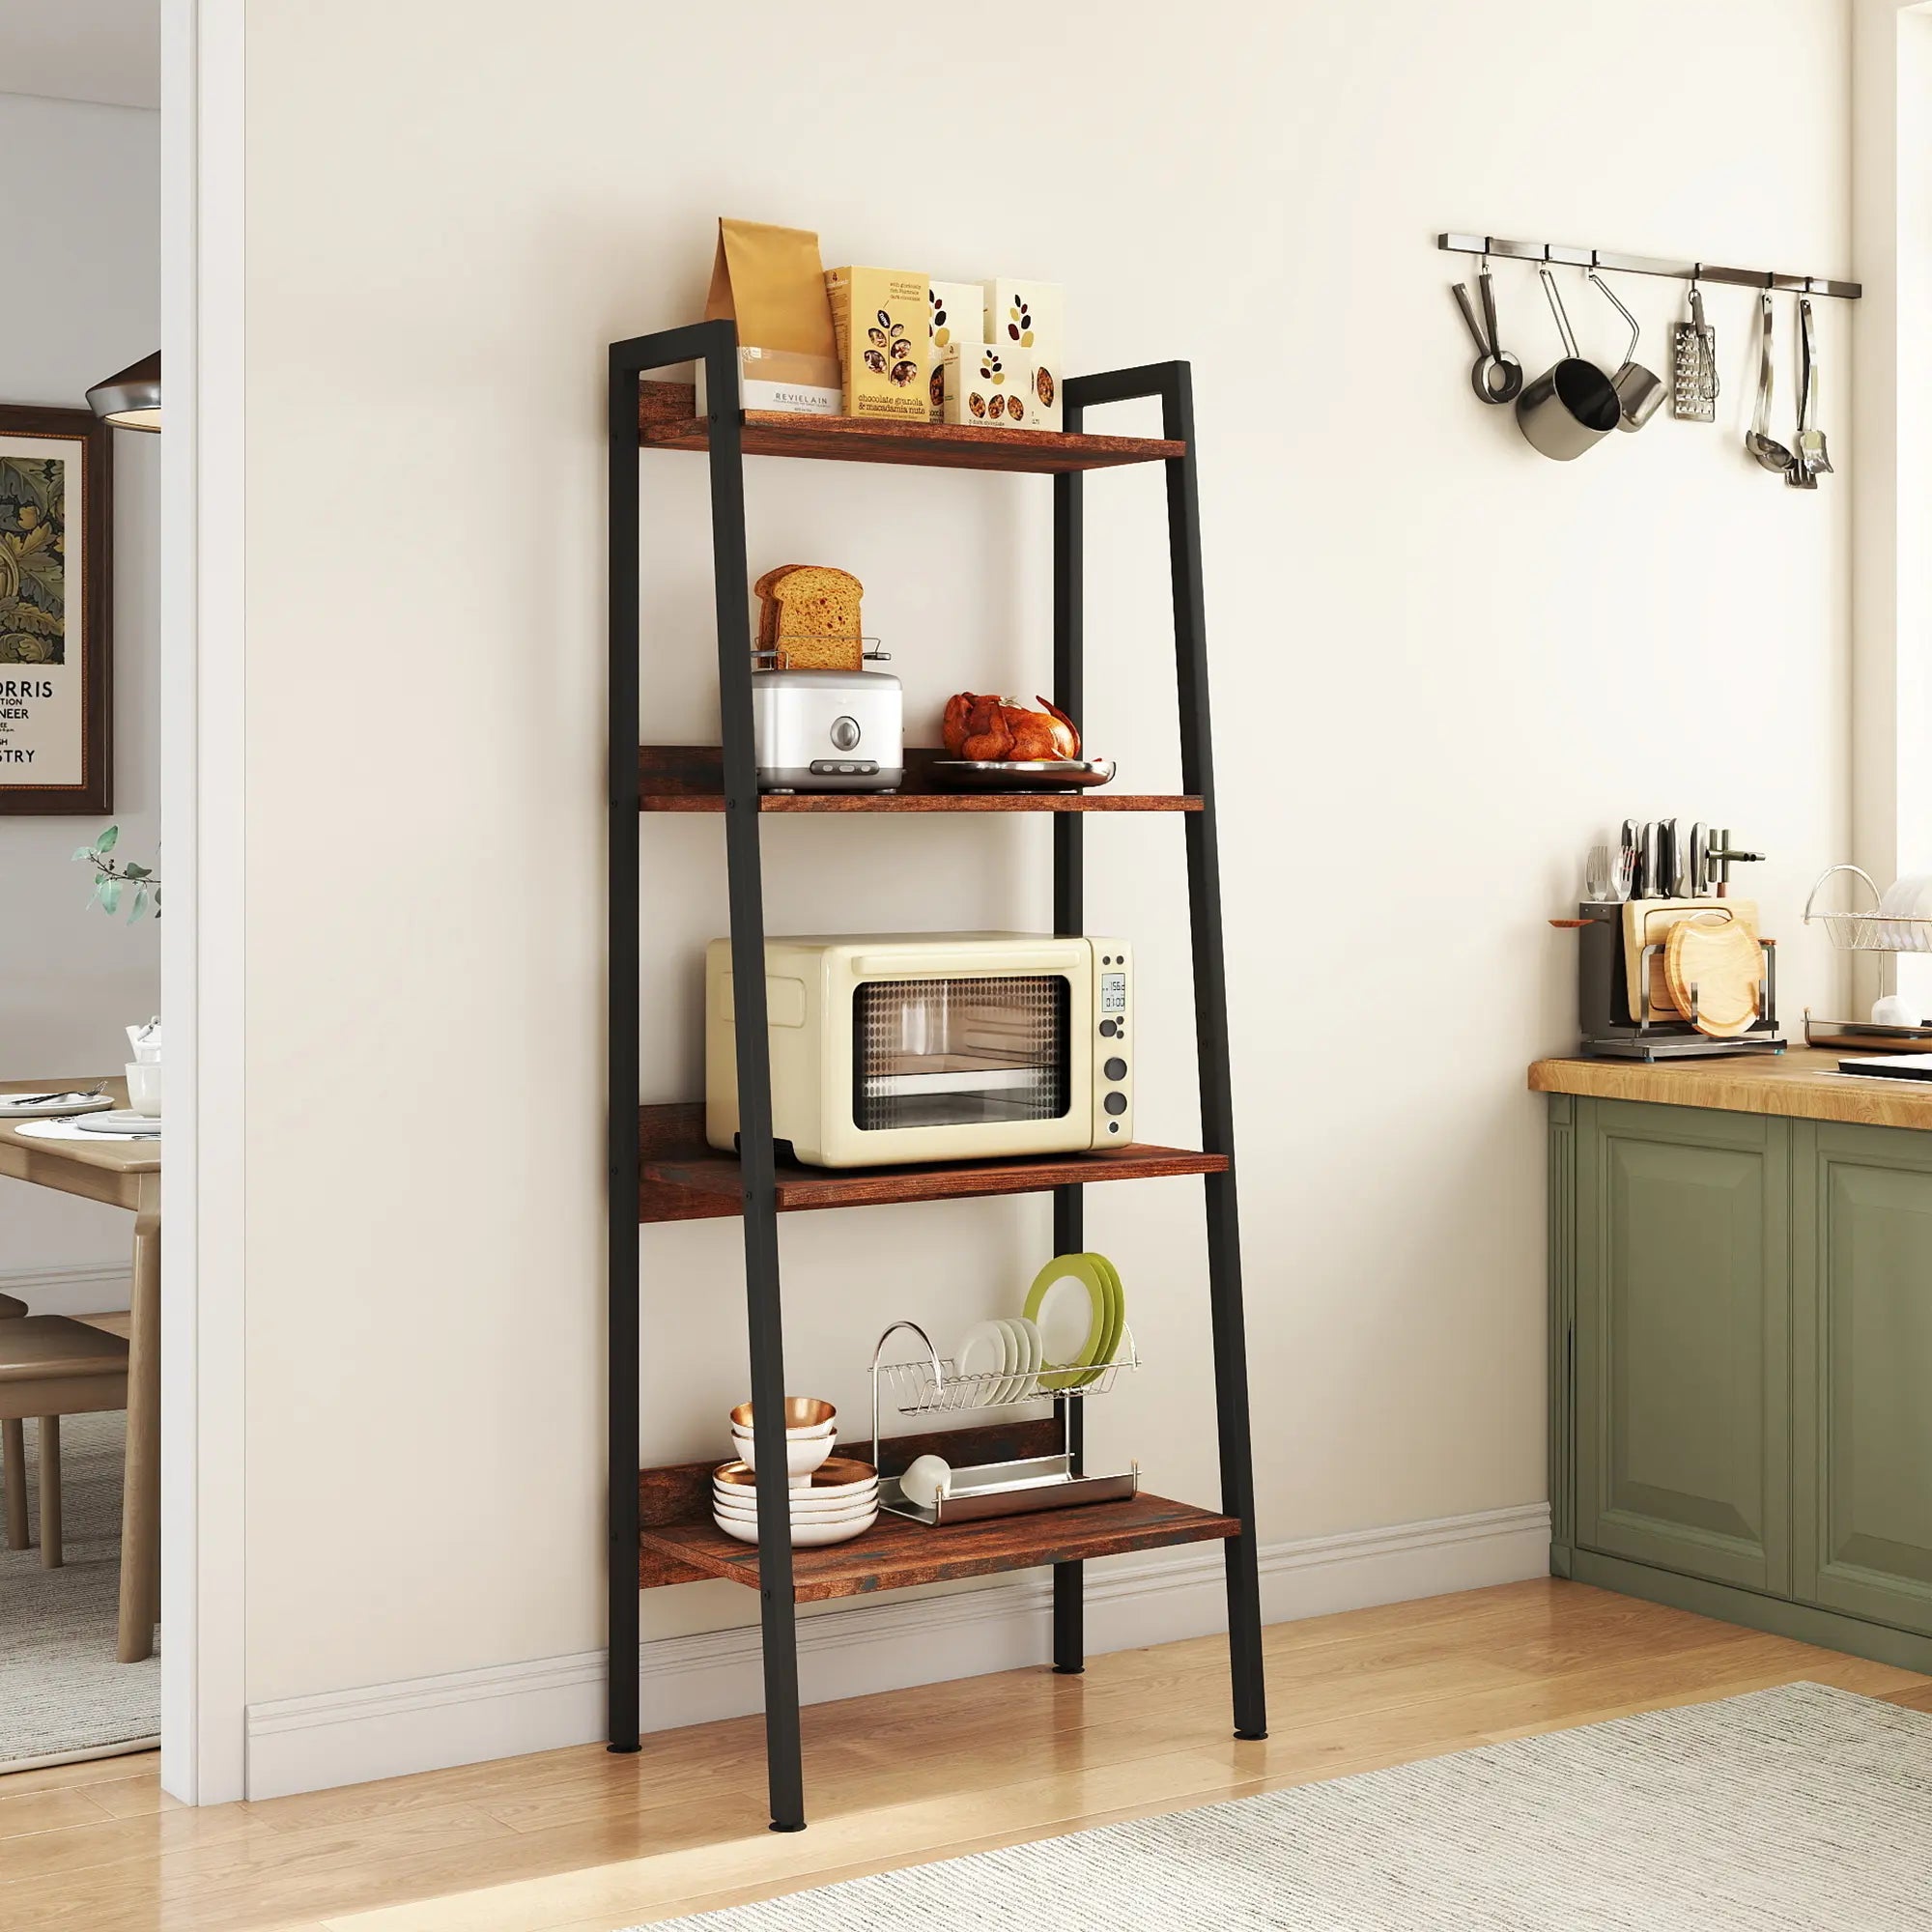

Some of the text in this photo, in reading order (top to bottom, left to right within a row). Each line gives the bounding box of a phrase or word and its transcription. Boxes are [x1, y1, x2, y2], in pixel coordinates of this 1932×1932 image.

[775, 392, 828, 404] REVIELAIN
[858, 393, 923, 407] chocolate granola
[858, 402, 866, 411] &
[866, 404, 908, 413] macadamia
[0, 681, 53, 697] RRIS
